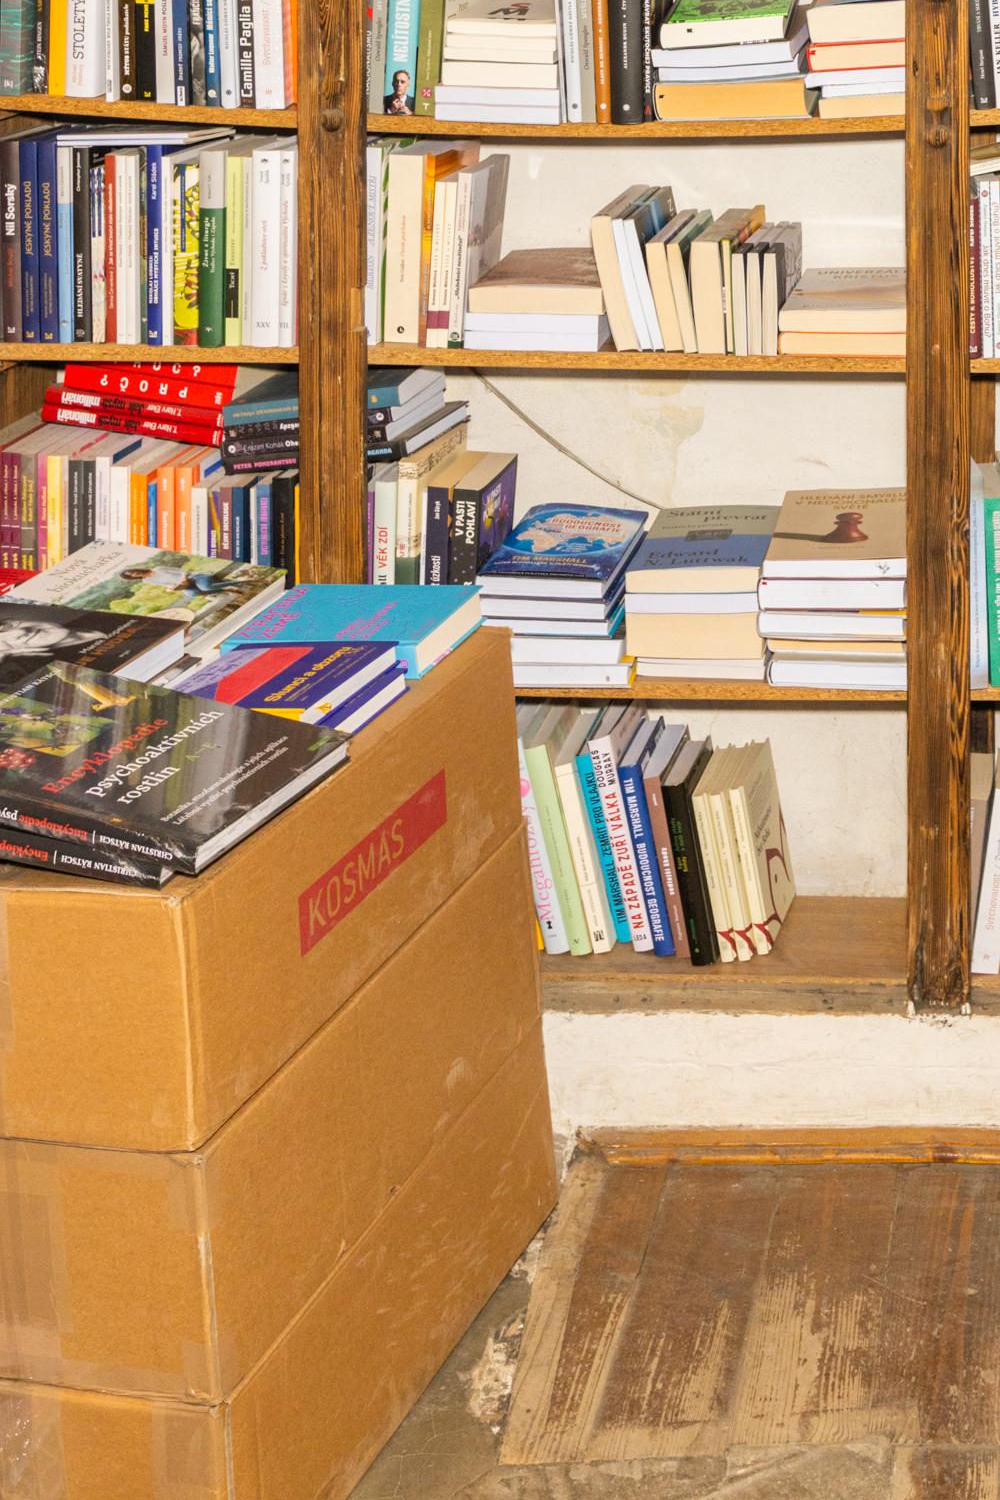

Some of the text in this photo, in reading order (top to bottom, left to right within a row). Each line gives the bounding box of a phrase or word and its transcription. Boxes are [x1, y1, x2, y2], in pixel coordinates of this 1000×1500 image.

[239, 6, 254, 98] Camille Paglia
[5, 184, 17, 236] Nil Sorský
[455, 501, 465, 536] V PASTI
[465, 501, 476, 544] POHLAVÍ
[42, 718, 169, 792] Encyklopedie
[85, 710, 225, 797] psychoaktivních
[117, 766, 181, 804] rostlin
[307, 818, 405, 935] KOSMAS
[605, 790, 643, 929] NA ZÁPADĚ ZUŘÍ VÁLKA
[624, 778, 664, 942] TIM MARSHALL BUDOUCNOST GEOGRAFIE
